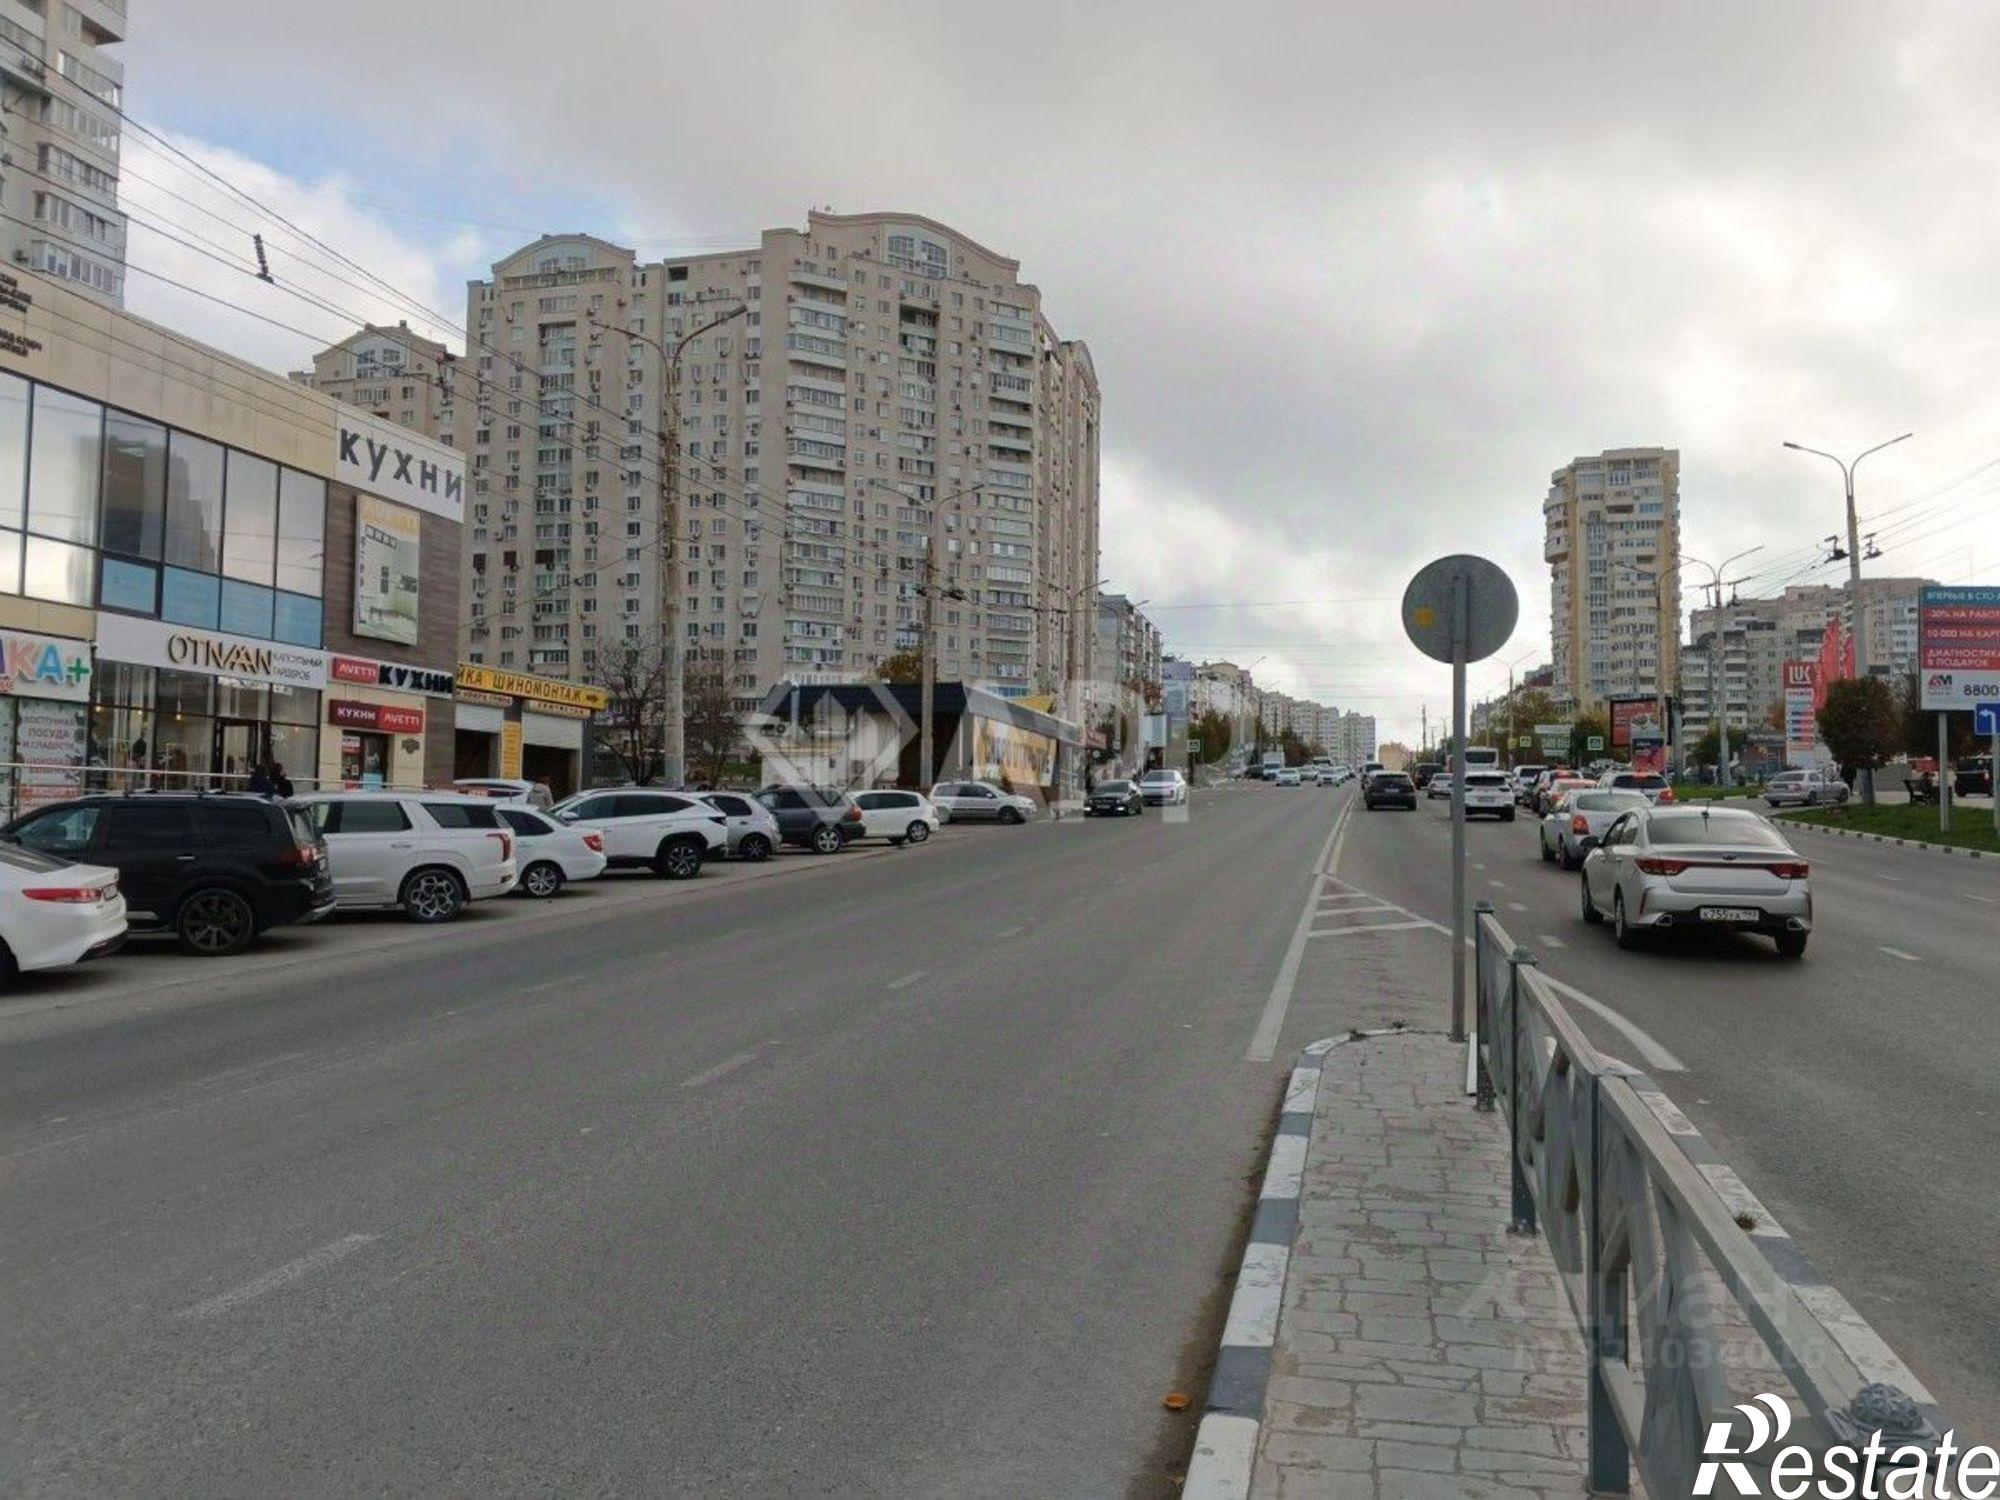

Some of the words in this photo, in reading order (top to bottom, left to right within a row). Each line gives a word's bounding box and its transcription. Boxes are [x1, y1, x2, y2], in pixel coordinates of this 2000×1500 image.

[339, 427, 463, 503] КУХНИ
[0, 637, 90, 683] КА+
[338, 663, 376, 678] AVETTI
[379, 664, 454, 694] КУХНИ
[493, 674, 582, 702] ШИНОМОНТАЖ
[1964, 683, 1999, 696] 8800
[337, 707, 376, 721] КУХНИ
[384, 712, 420, 726] AVETTI
